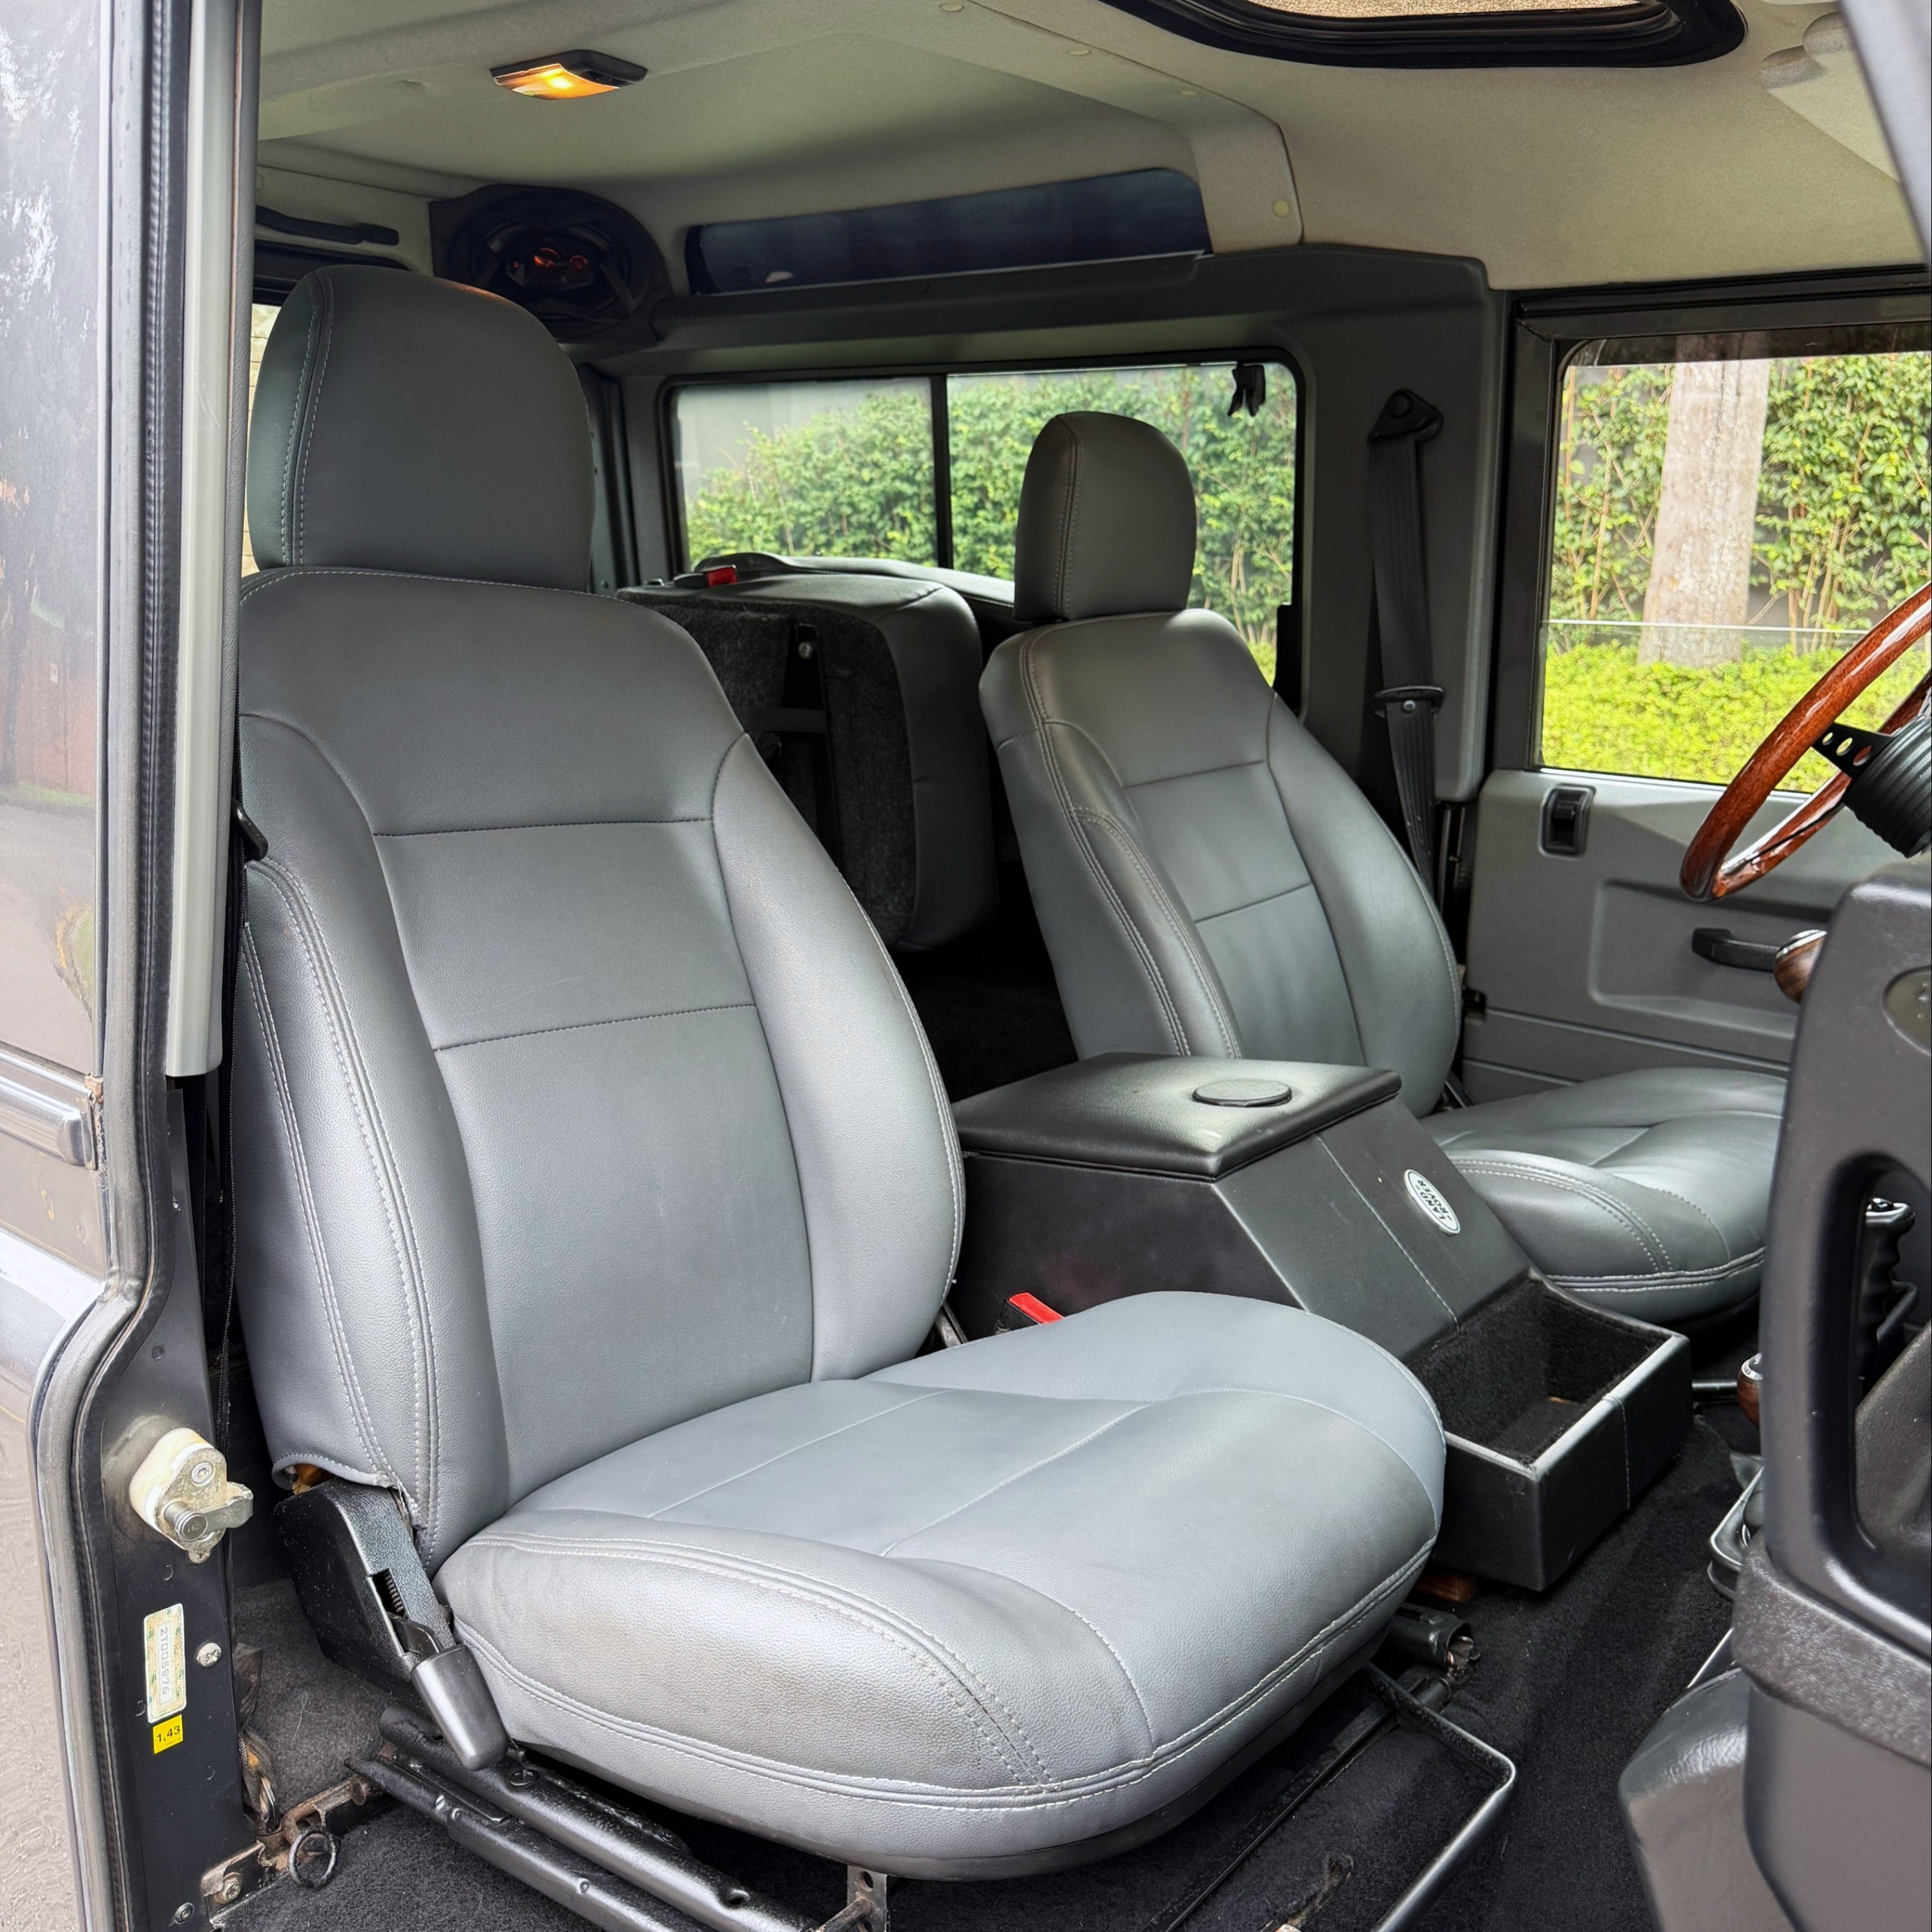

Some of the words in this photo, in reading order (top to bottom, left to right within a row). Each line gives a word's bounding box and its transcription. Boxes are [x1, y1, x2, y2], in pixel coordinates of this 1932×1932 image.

[1418, 1180, 1449, 1213] ROVER
[1420, 1192, 1446, 1220] LAND
[157, 1725, 181, 1742] 1,43
